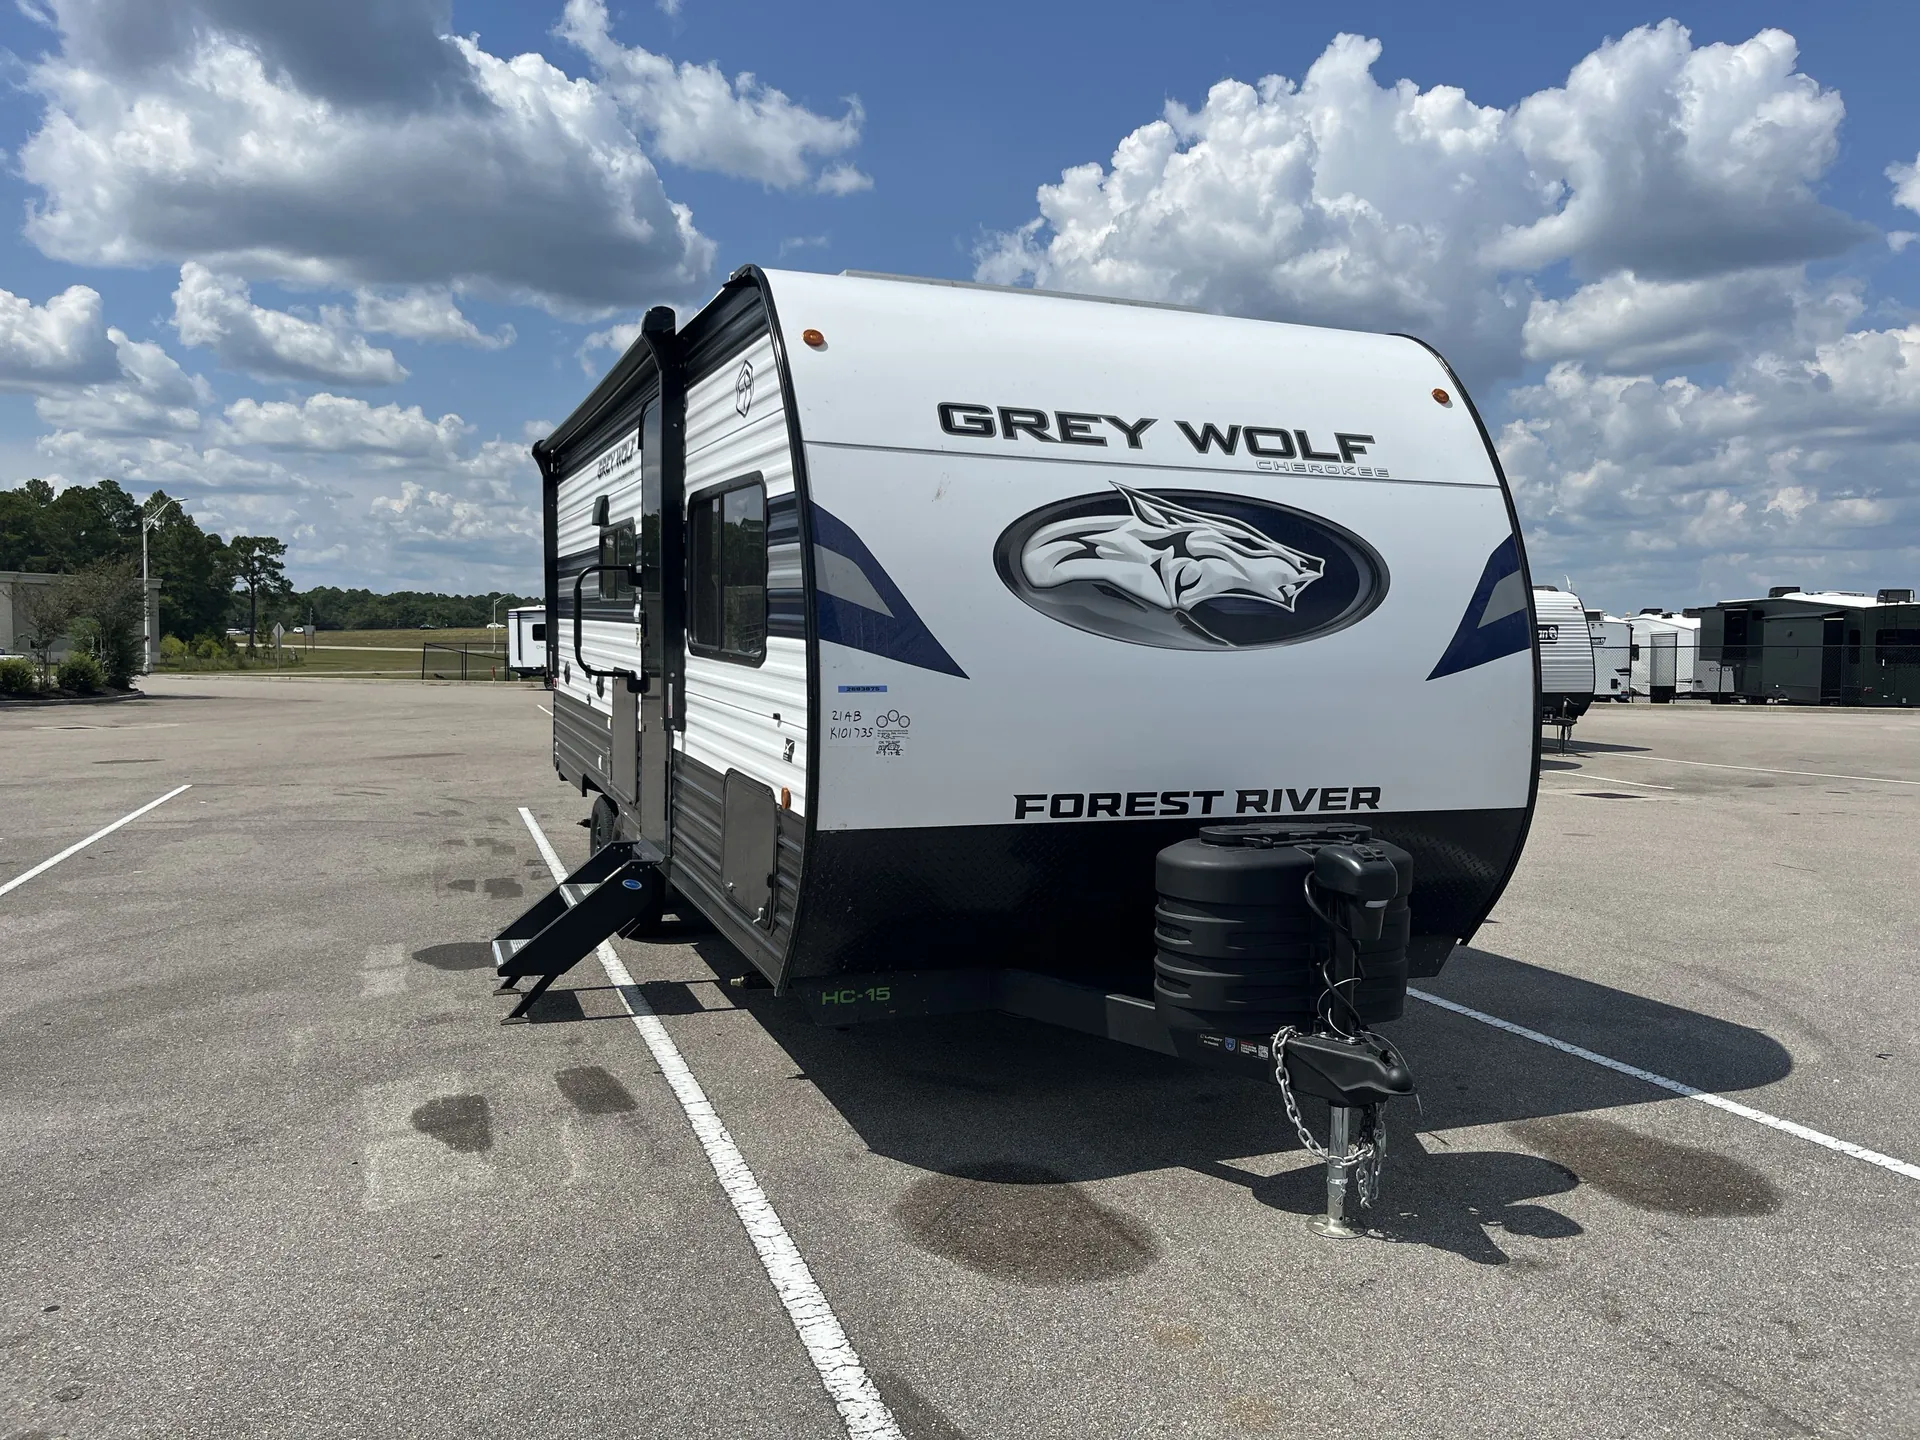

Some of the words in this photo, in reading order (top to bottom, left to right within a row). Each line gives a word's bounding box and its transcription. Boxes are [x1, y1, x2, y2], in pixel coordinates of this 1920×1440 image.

[937, 402, 1159, 450] GREY
[1174, 420, 1376, 463] WOLF
[1256, 460, 1390, 477] CHEROKEE
[830, 727, 873, 740] K101735
[1013, 789, 1225, 820] FOREST
[1233, 786, 1382, 814] RIVER
[821, 986, 891, 1006] HC-15
